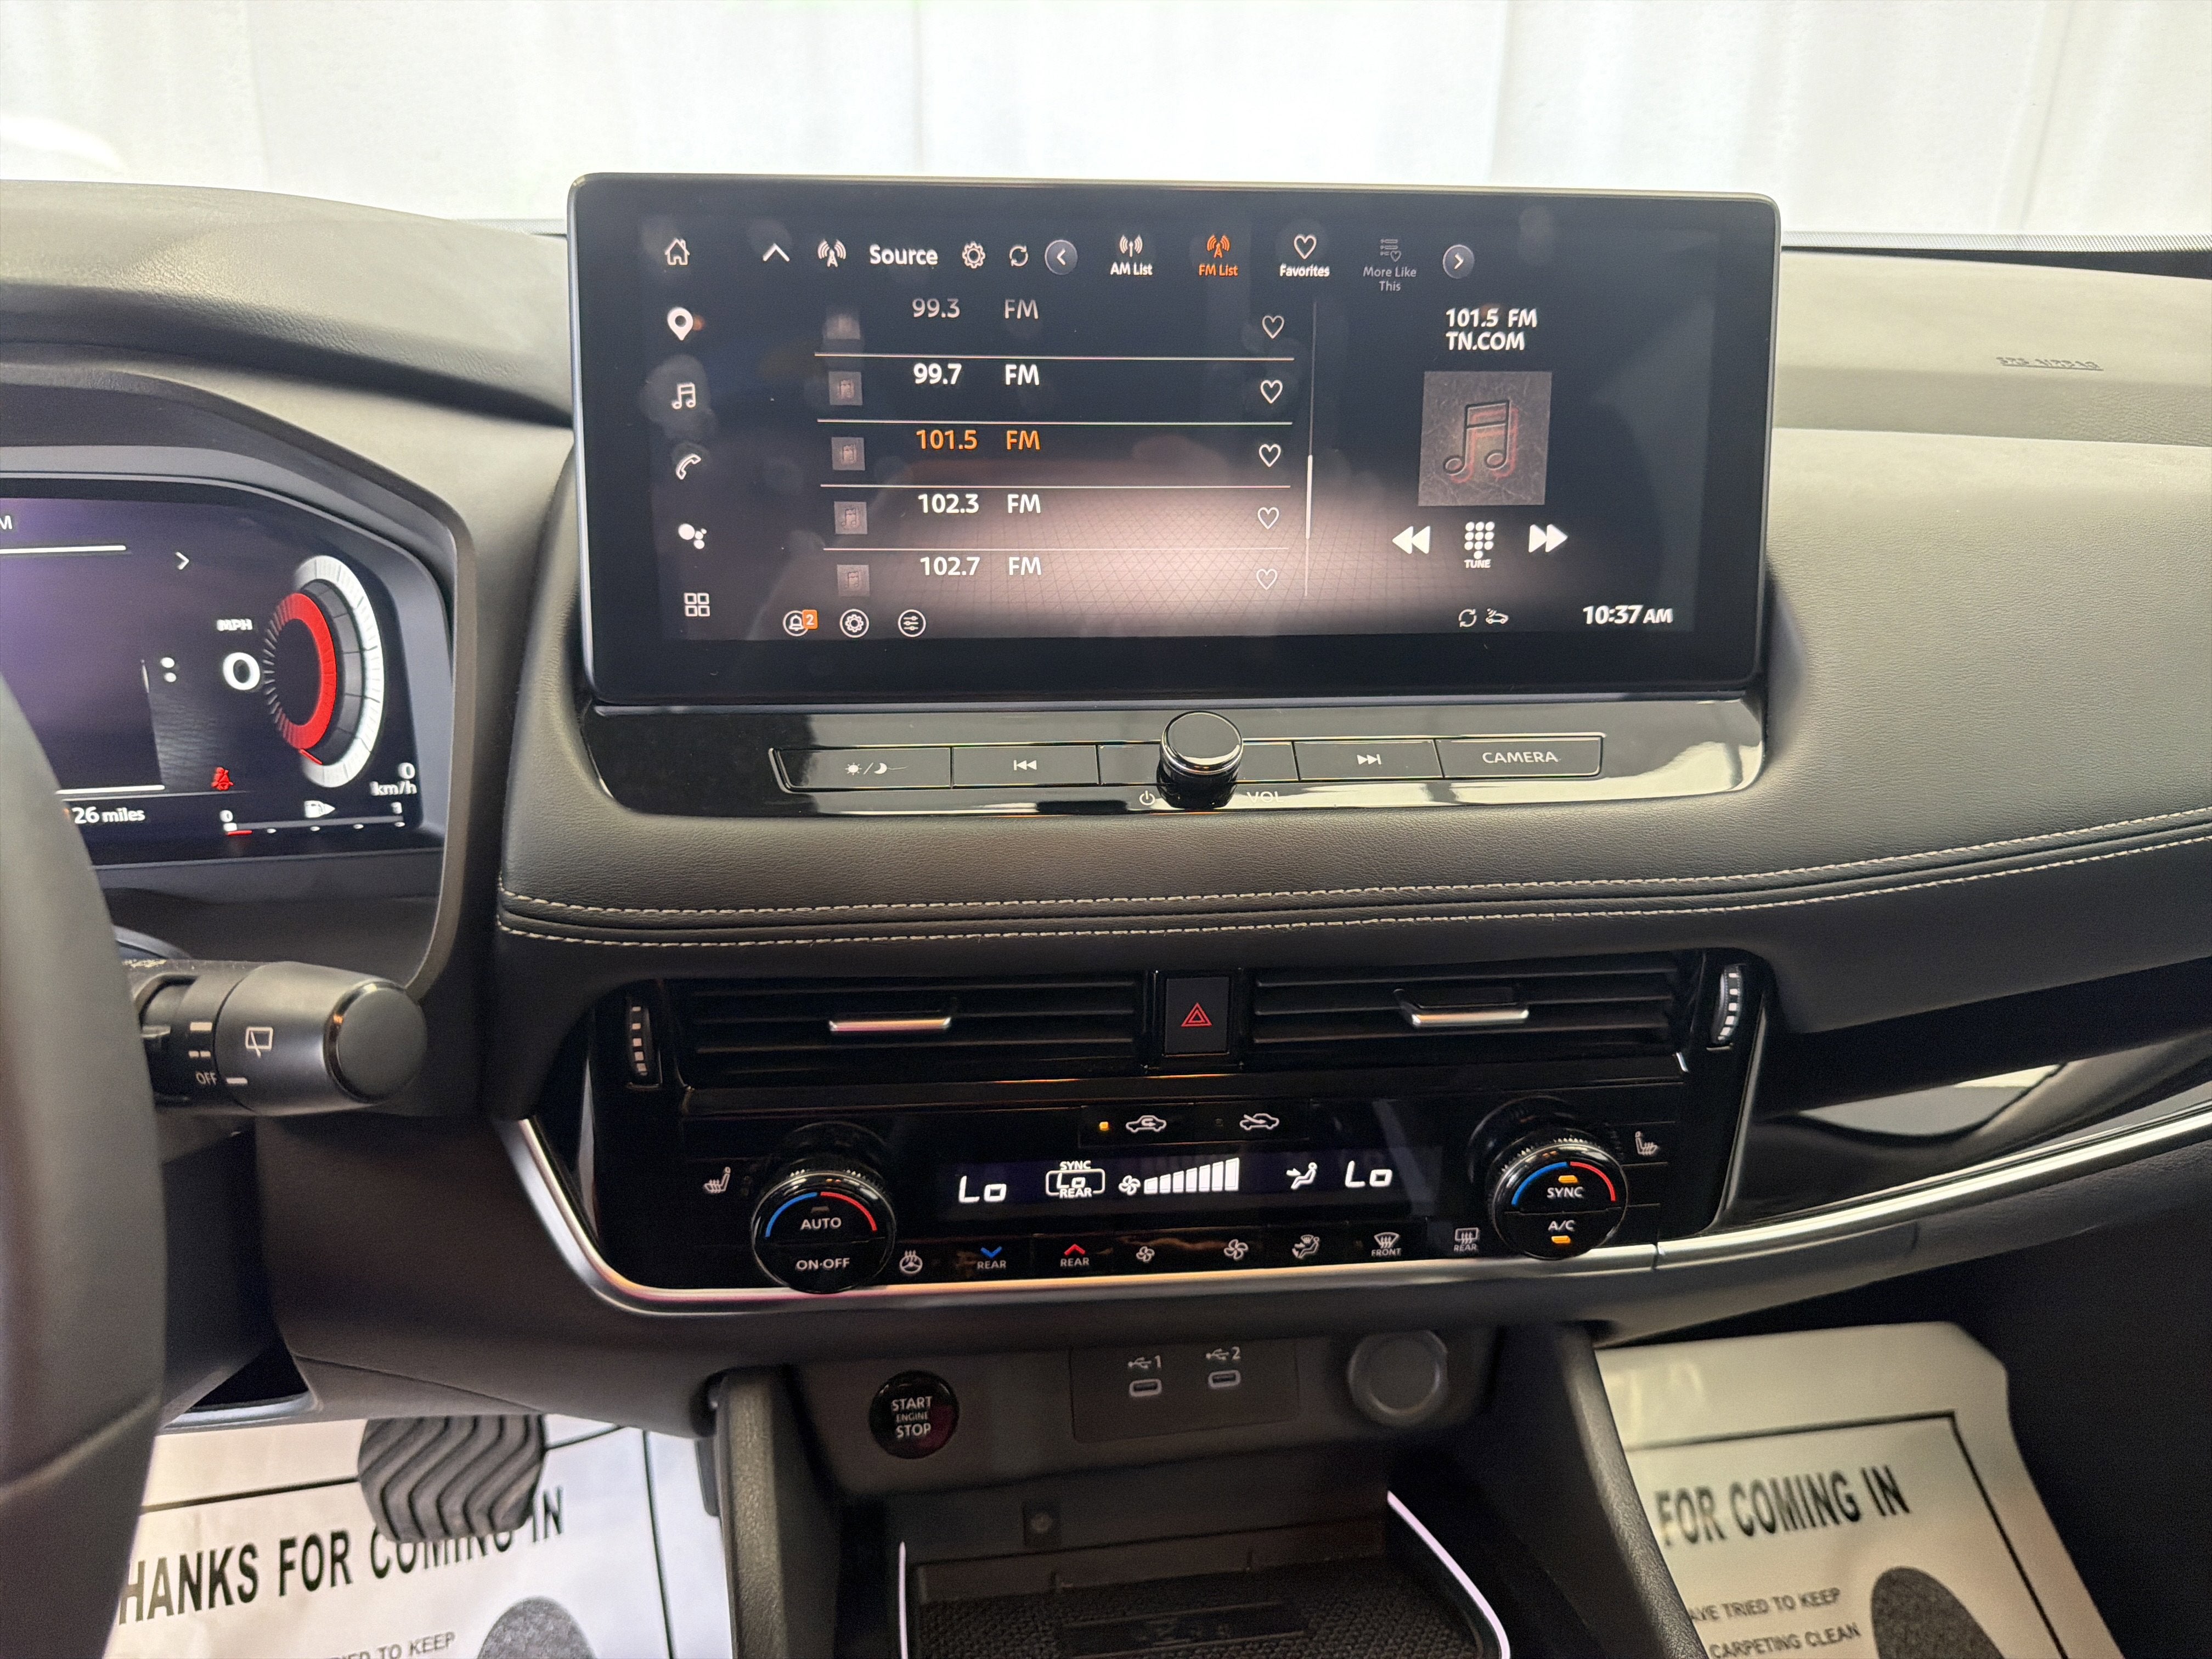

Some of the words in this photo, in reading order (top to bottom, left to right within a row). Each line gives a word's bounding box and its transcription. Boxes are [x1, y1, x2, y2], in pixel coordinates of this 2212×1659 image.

[870, 244, 938, 265] Source
[1110, 262, 1131, 275] AM
[1133, 262, 1153, 275] List
[1199, 264, 1216, 276] FM
[1219, 264, 1238, 276] List
[1279, 263, 1330, 277] Favorites
[1363, 266, 1392, 277] More
[1395, 266, 1417, 278] Like
[1379, 280, 1401, 291] This
[912, 299, 960, 318] 99.3
[1005, 300, 1039, 319] FM
[1446, 308, 1499, 328] 101.5
[1508, 308, 1537, 328] FM
[1446, 331, 1525, 351] TN.COM
[913, 363, 962, 385] 99.7
[1005, 364, 1040, 386] FM
[916, 430, 978, 450] 101.5
[1007, 430, 1040, 450] FM
[918, 493, 979, 514] 102.3
[1007, 494, 1041, 514] FM
[0, 515, 13, 531] M
[920, 556, 980, 576] 102.7
[1008, 556, 1042, 575] FM
[1464, 559, 1491, 568] TUNE
[805, 613, 815, 627] 2
[1583, 605, 1642, 624] 10:37
[1643, 608, 1673, 624] AM
[216, 618, 253, 631] MPH
[222, 652, 261, 691] 0
[1482, 751, 1558, 764] CAMERA
[398, 762, 415, 780] 0
[369, 780, 419, 797] km/h
[1247, 791, 1283, 803] VOL
[71, 806, 100, 824] 26
[101, 807, 145, 823] miles
[220, 810, 233, 823] 0
[195, 1071, 217, 1085] OFF
[1059, 1160, 1092, 1170] SYNC
[1056, 1174, 1087, 1188] Lo
[1345, 1160, 1392, 1188] Lo
[958, 1175, 1007, 1203] Lo
[1058, 1187, 1093, 1198] REAR
[1547, 1186, 1583, 1198] SYNC
[800, 1217, 842, 1230] AUTO
[1548, 1220, 1575, 1231] A/C
[1371, 1246, 1401, 1256] FRONT
[1453, 1243, 1477, 1252] REAR
[977, 1260, 1007, 1269] REAR
[1060, 1257, 1090, 1267] REAR
[1232, 1346, 1240, 1361] 2
[1154, 1355, 1161, 1368] 1
[891, 1396, 932, 1412] START
[896, 1410, 928, 1423] ENGINE
[896, 1423, 932, 1438] STOP
[1655, 1486, 1727, 1546] FOR
[1729, 1471, 1861, 1537] COMING
[1860, 1465, 1910, 1517] IN
[119, 1543, 259, 1625] HANKS
[279, 1528, 353, 1596] FOR
[532, 1485, 564, 1543] IN
[1689, 1604, 1719, 1622] AVE
[1722, 1597, 1769, 1620] TRIED
[1771, 1595, 1797, 1612] TO
[1800, 1587, 1841, 1608] KEEP
[377, 1644, 403, 1659] TO
[409, 1631, 456, 1657] KEEP
[1709, 1633, 1803, 1659] CARPETING
[1803, 1622, 1861, 1647] CLEAN
